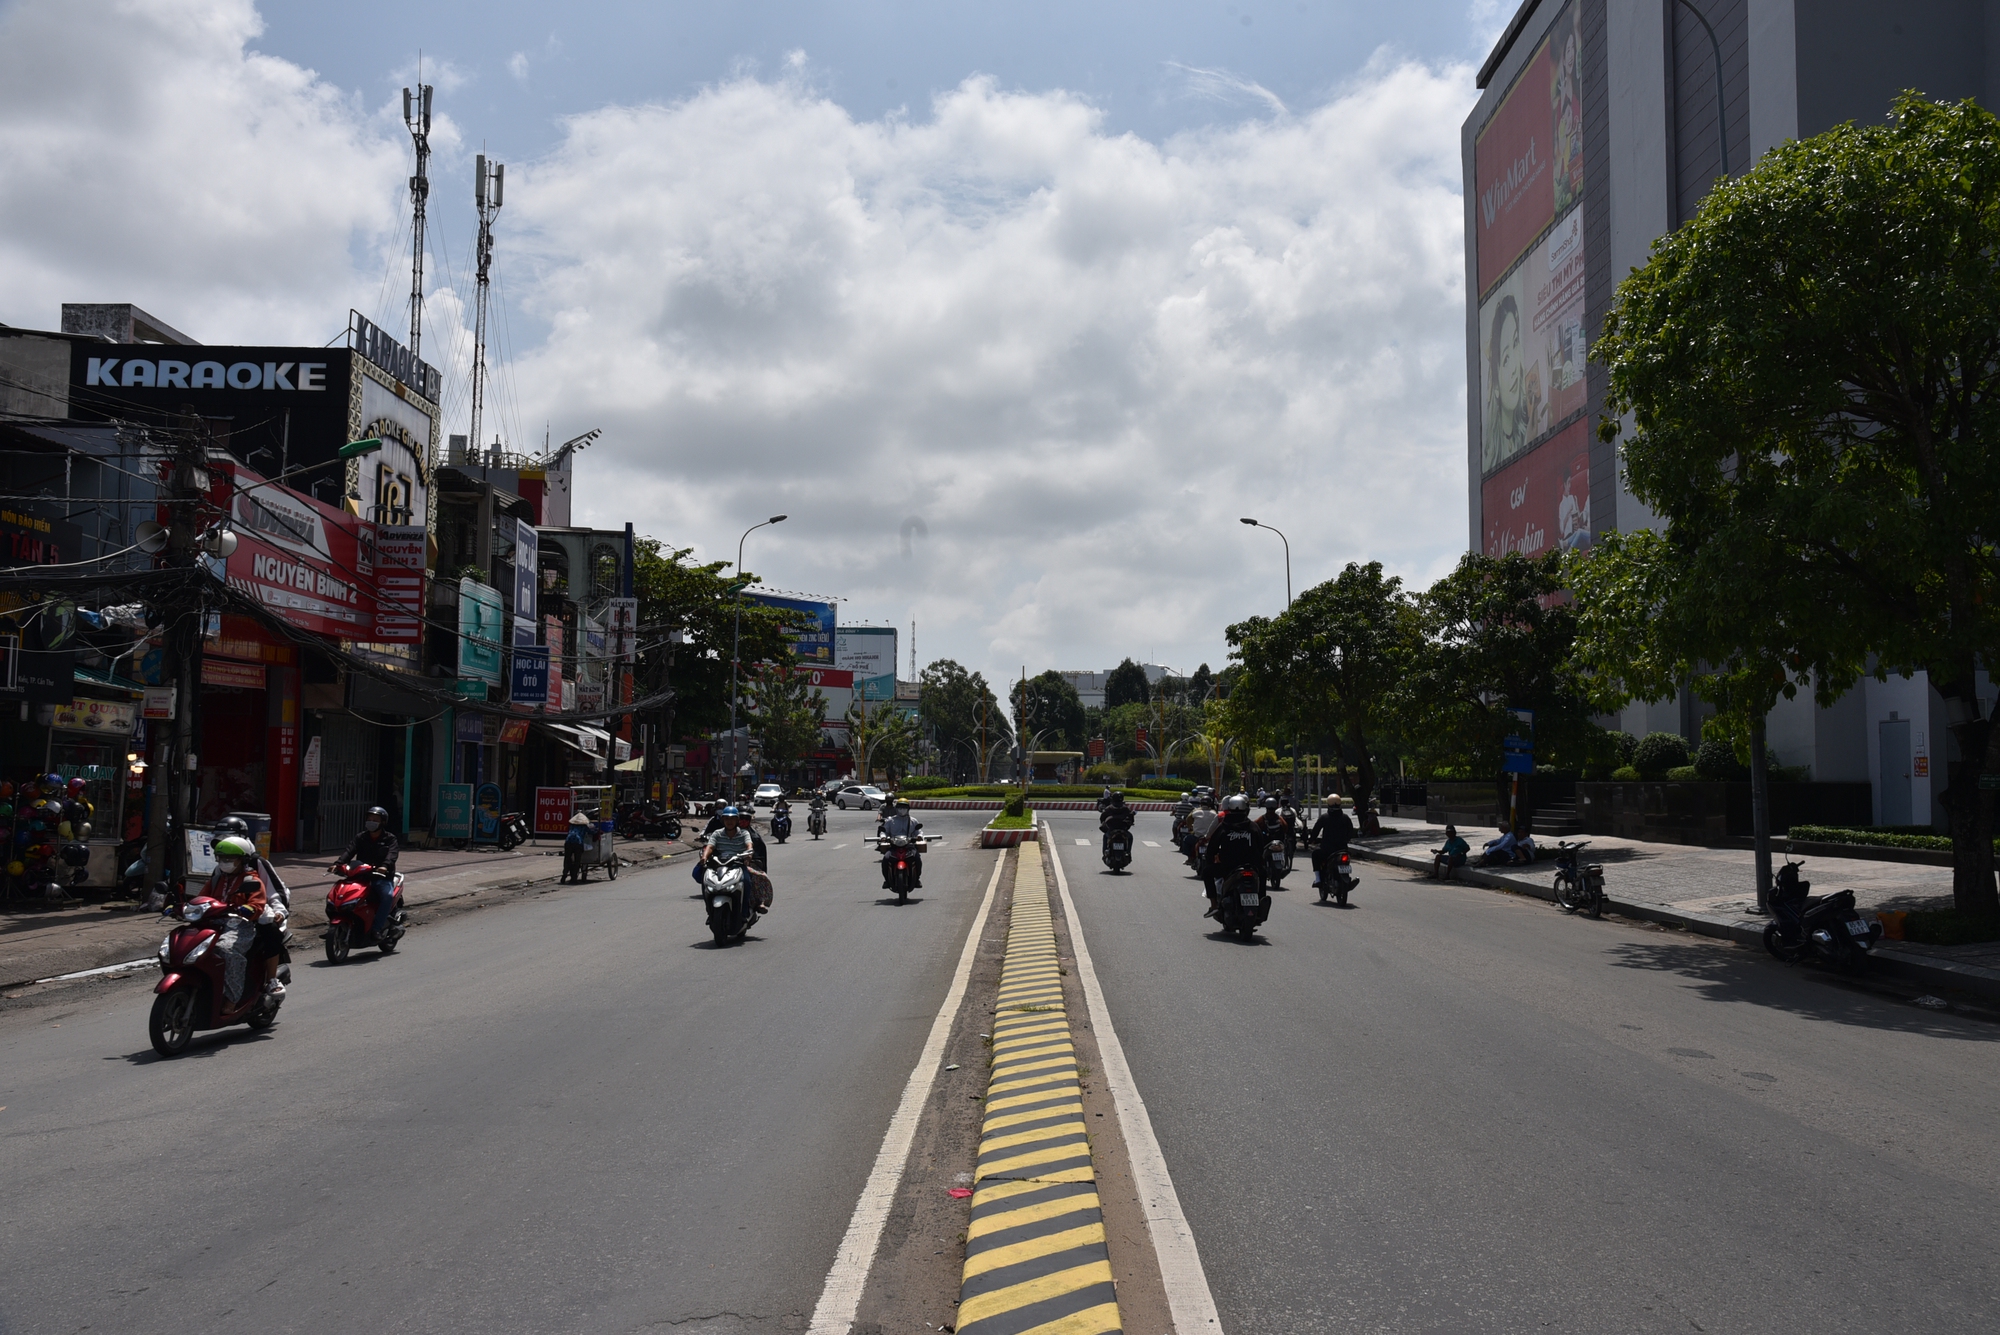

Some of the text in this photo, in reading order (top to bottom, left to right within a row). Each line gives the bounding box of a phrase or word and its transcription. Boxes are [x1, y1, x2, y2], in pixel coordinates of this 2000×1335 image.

[1481, 136, 1537, 230] WinMart
[356, 314, 425, 396] KARAOKE
[85, 357, 327, 392] KARAOKE
[367, 418, 400, 442] ARAOKE
[1510, 484, 1524, 510] CGV
[1, 510, 17, 525] NÓN
[18, 513, 33, 529] BẢO
[49, 544, 59, 564] 5
[378, 543, 422, 554] NGUYỄN
[519, 540, 529, 572] HỌC
[253, 553, 314, 592] NGUYỄN
[349, 583, 357, 604] 2
[521, 582, 531, 614] ÔTÔ
[614, 610, 631, 623] HA
[516, 657, 546, 671] HỌC LÁI
[522, 674, 537, 687] ÔTÔ
[89, 703, 129, 715] QUAY
[459, 718, 467, 735] HỌC
[80, 765, 116, 781] QUAY
[441, 790, 467, 800] Trà Sữa
[540, 797, 568, 807] HỌC LÁI
[544, 811, 563, 821] Ô TÔ
